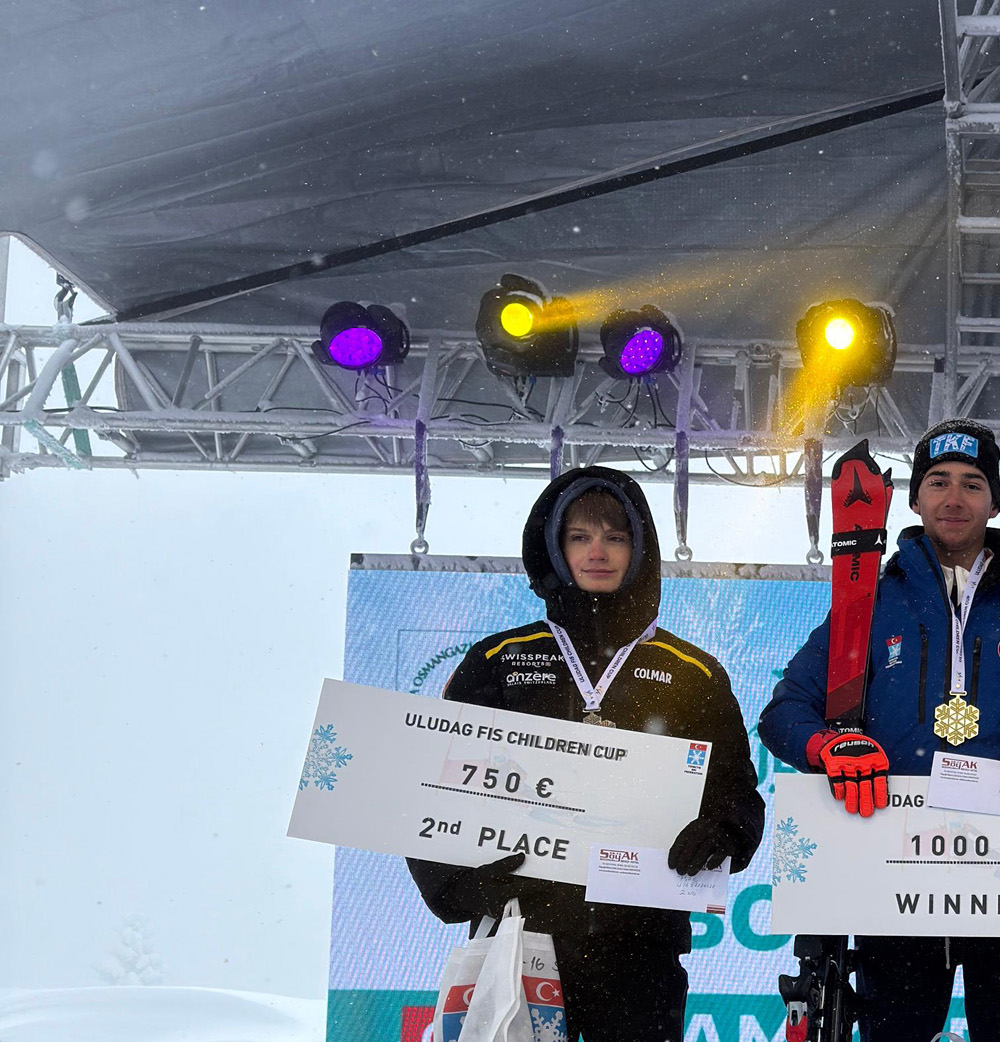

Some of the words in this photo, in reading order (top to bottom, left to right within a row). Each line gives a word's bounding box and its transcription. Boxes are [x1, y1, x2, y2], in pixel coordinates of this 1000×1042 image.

[932, 434, 975, 455] TKF
[634, 667, 673, 684] COLMAR
[404, 712, 473, 736] ULUDAG
[477, 725, 503, 742] FIS
[506, 730, 592, 757] CHILDREN
[593, 745, 628, 762] CUP
[834, 740, 875, 752] reusch
[461, 764, 521, 793] 750
[535, 777, 554, 799] €
[419, 817, 462, 839] 2nd
[477, 827, 570, 861] PLACE
[910, 834, 989, 857] 1000
